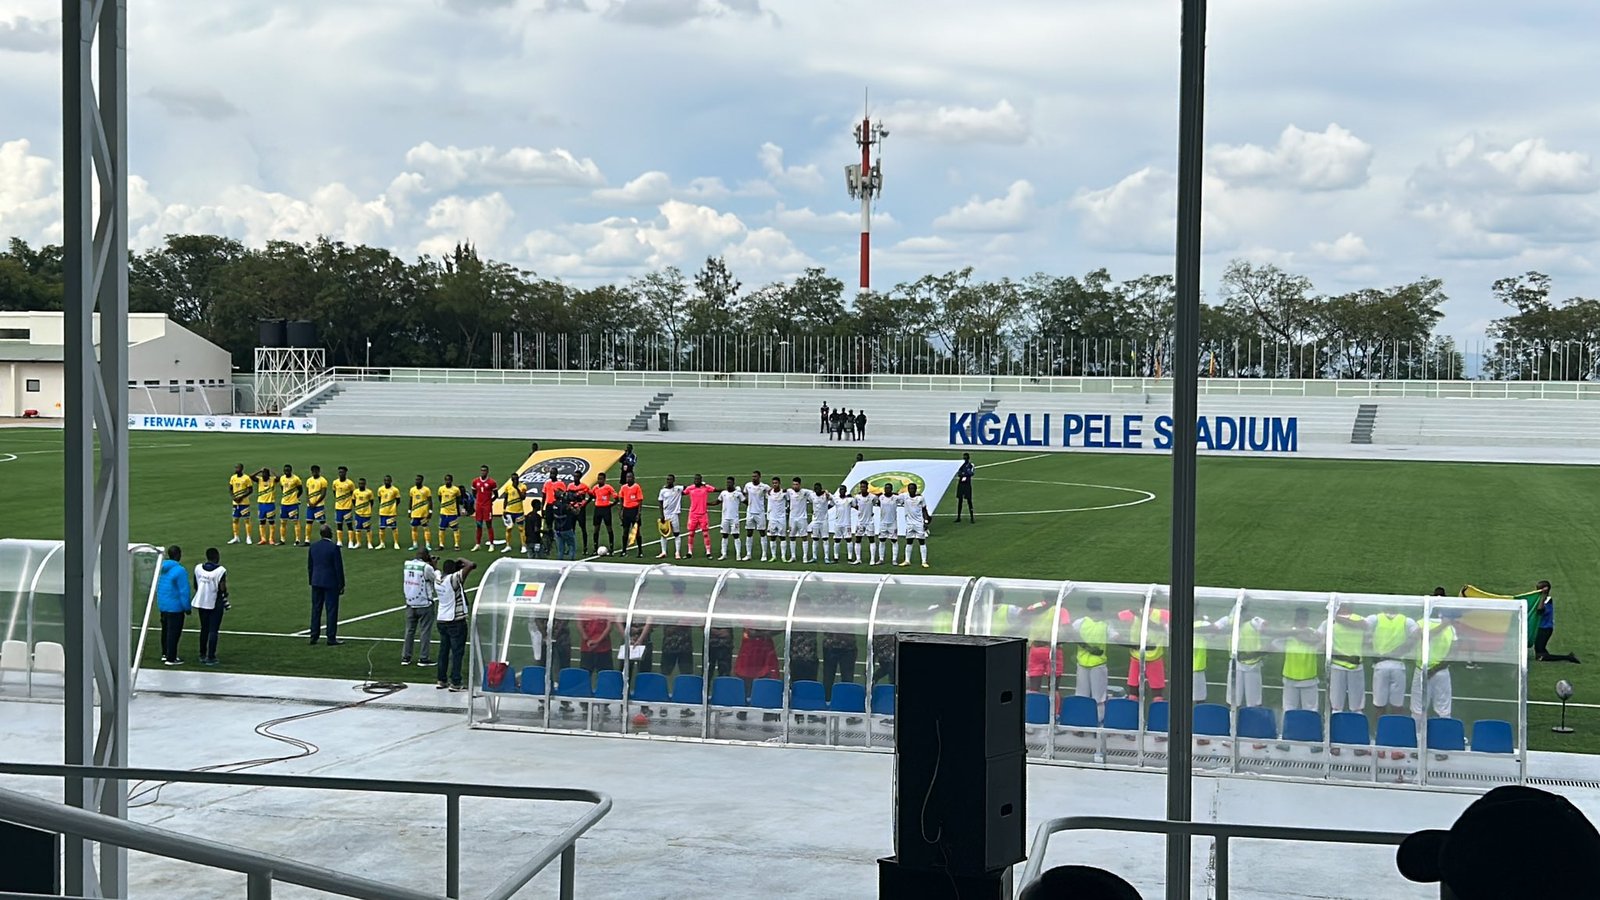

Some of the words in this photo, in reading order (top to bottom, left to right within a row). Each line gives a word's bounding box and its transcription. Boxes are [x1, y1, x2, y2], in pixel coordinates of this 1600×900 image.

[144, 416, 198, 428] FERWAFA
[240, 418, 295, 430] FERWAFA
[950, 412, 1050, 445] KIGALI
[1063, 414, 1143, 448] PELE
[1153, 415, 1297, 451] SADIUM
